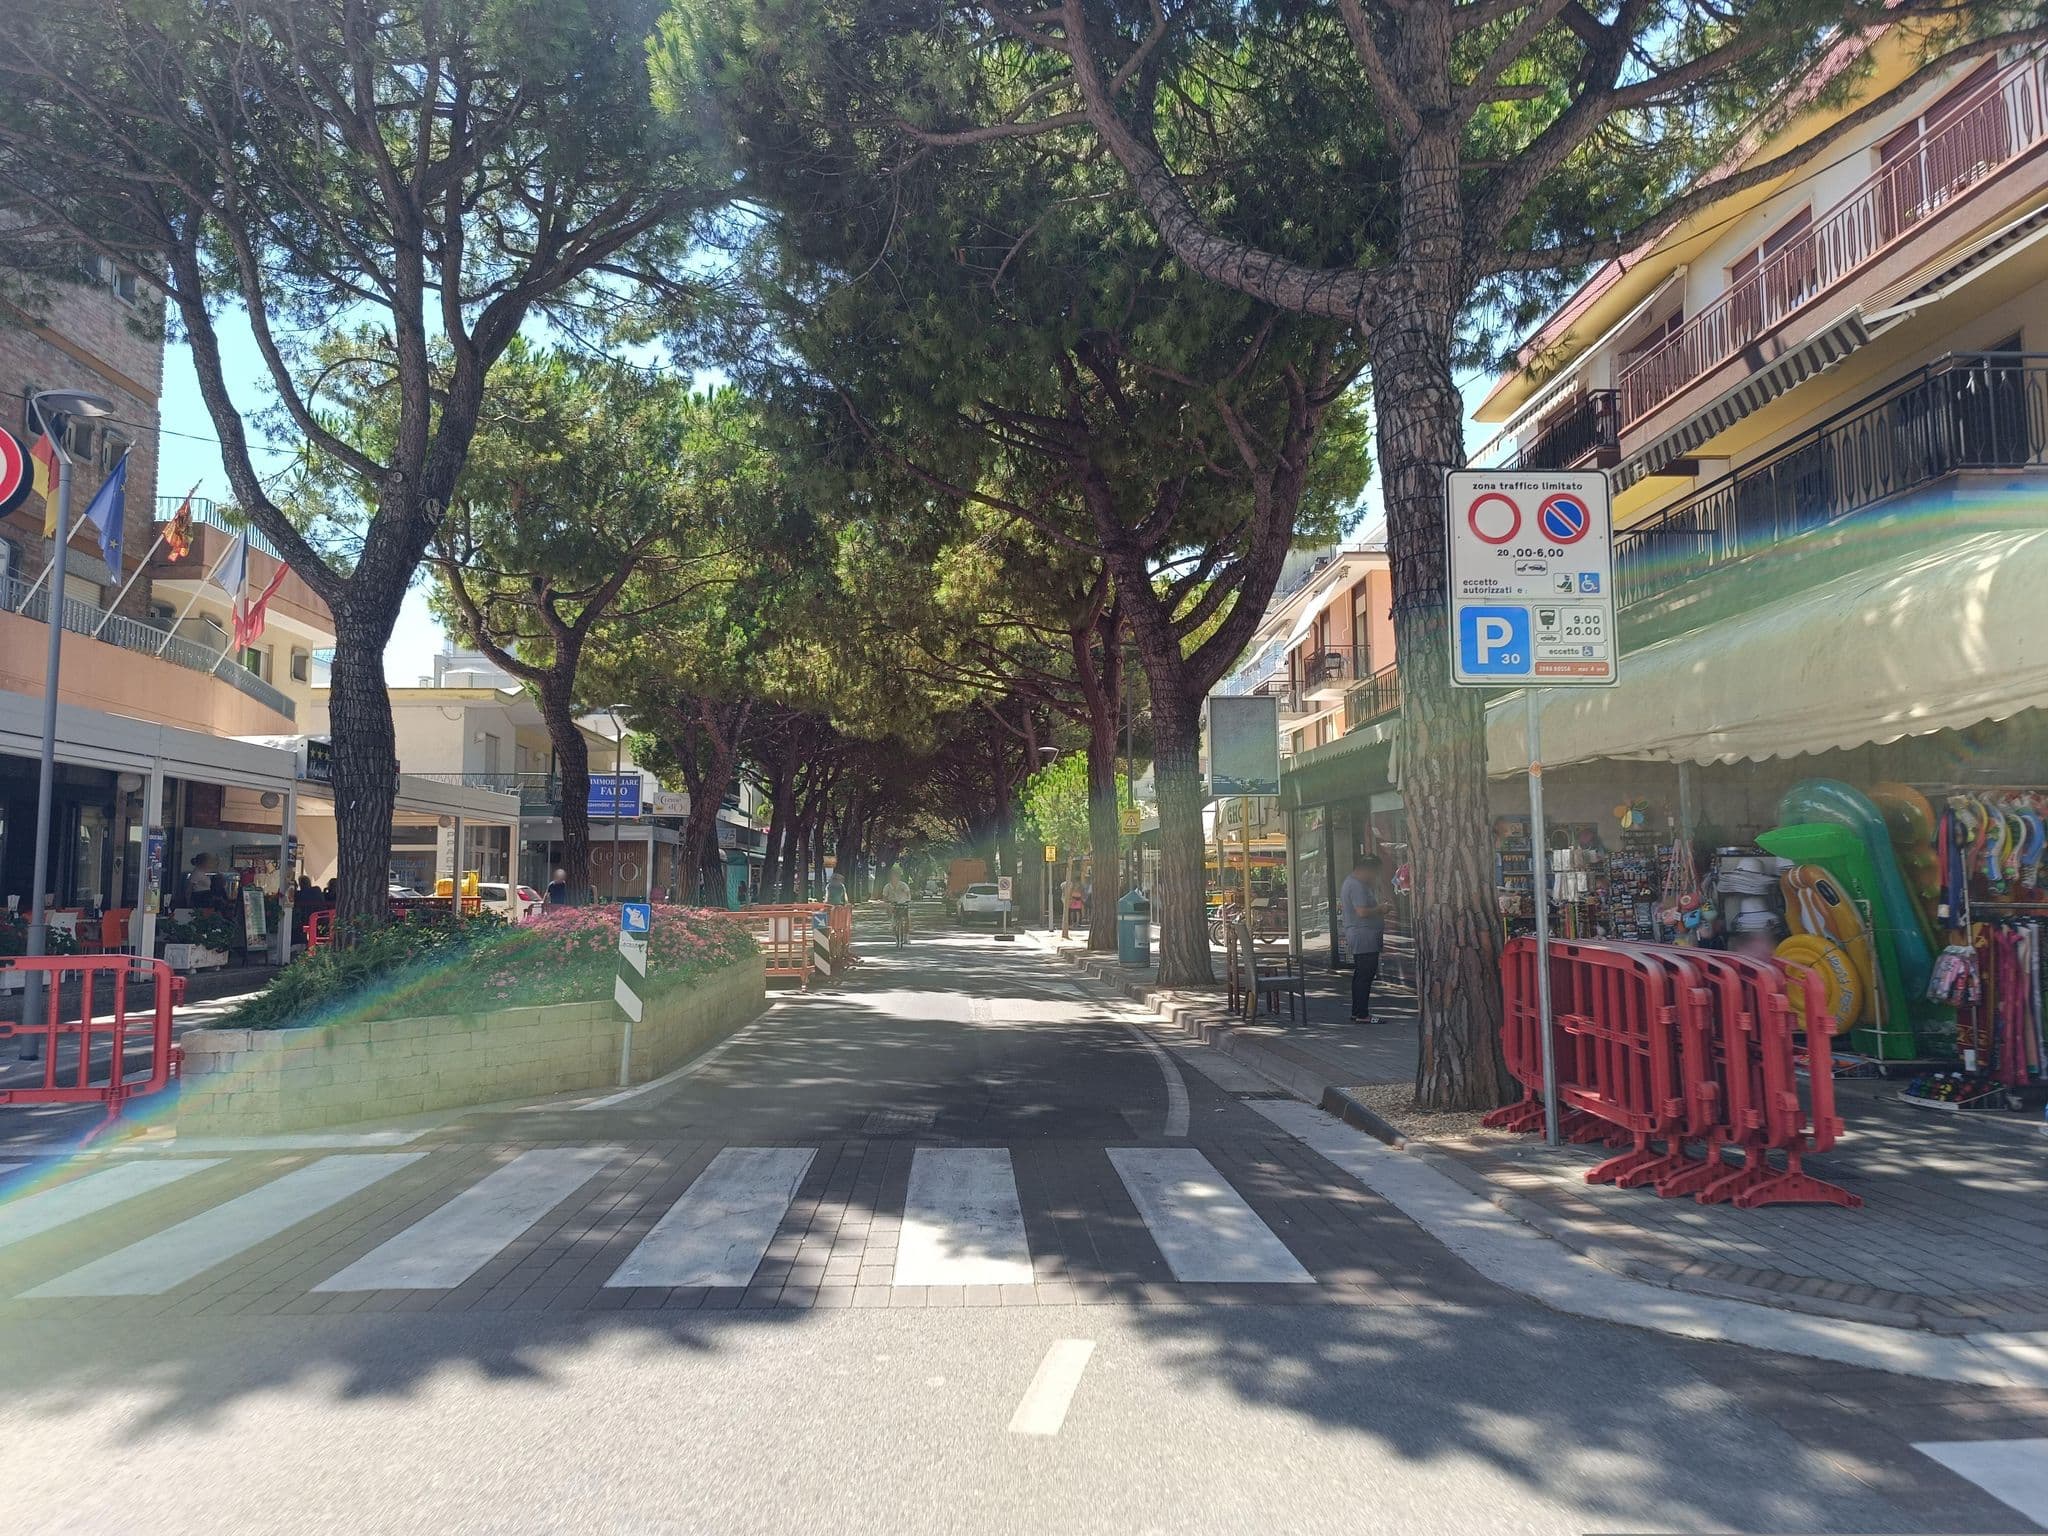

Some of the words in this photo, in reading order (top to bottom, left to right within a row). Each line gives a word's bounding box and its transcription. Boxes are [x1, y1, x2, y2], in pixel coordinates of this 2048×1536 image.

[1472, 482, 1496, 490] zona
[1499, 482, 1539, 490] traffico
[1542, 482, 1583, 490] limitato
[1463, 586, 1512, 594] autorizzati
[1573, 615, 1600, 624] 9.00
[1566, 626, 1601, 636] 20.00
[1476, 617, 1514, 665] P
[1501, 653, 1521, 665] 30
